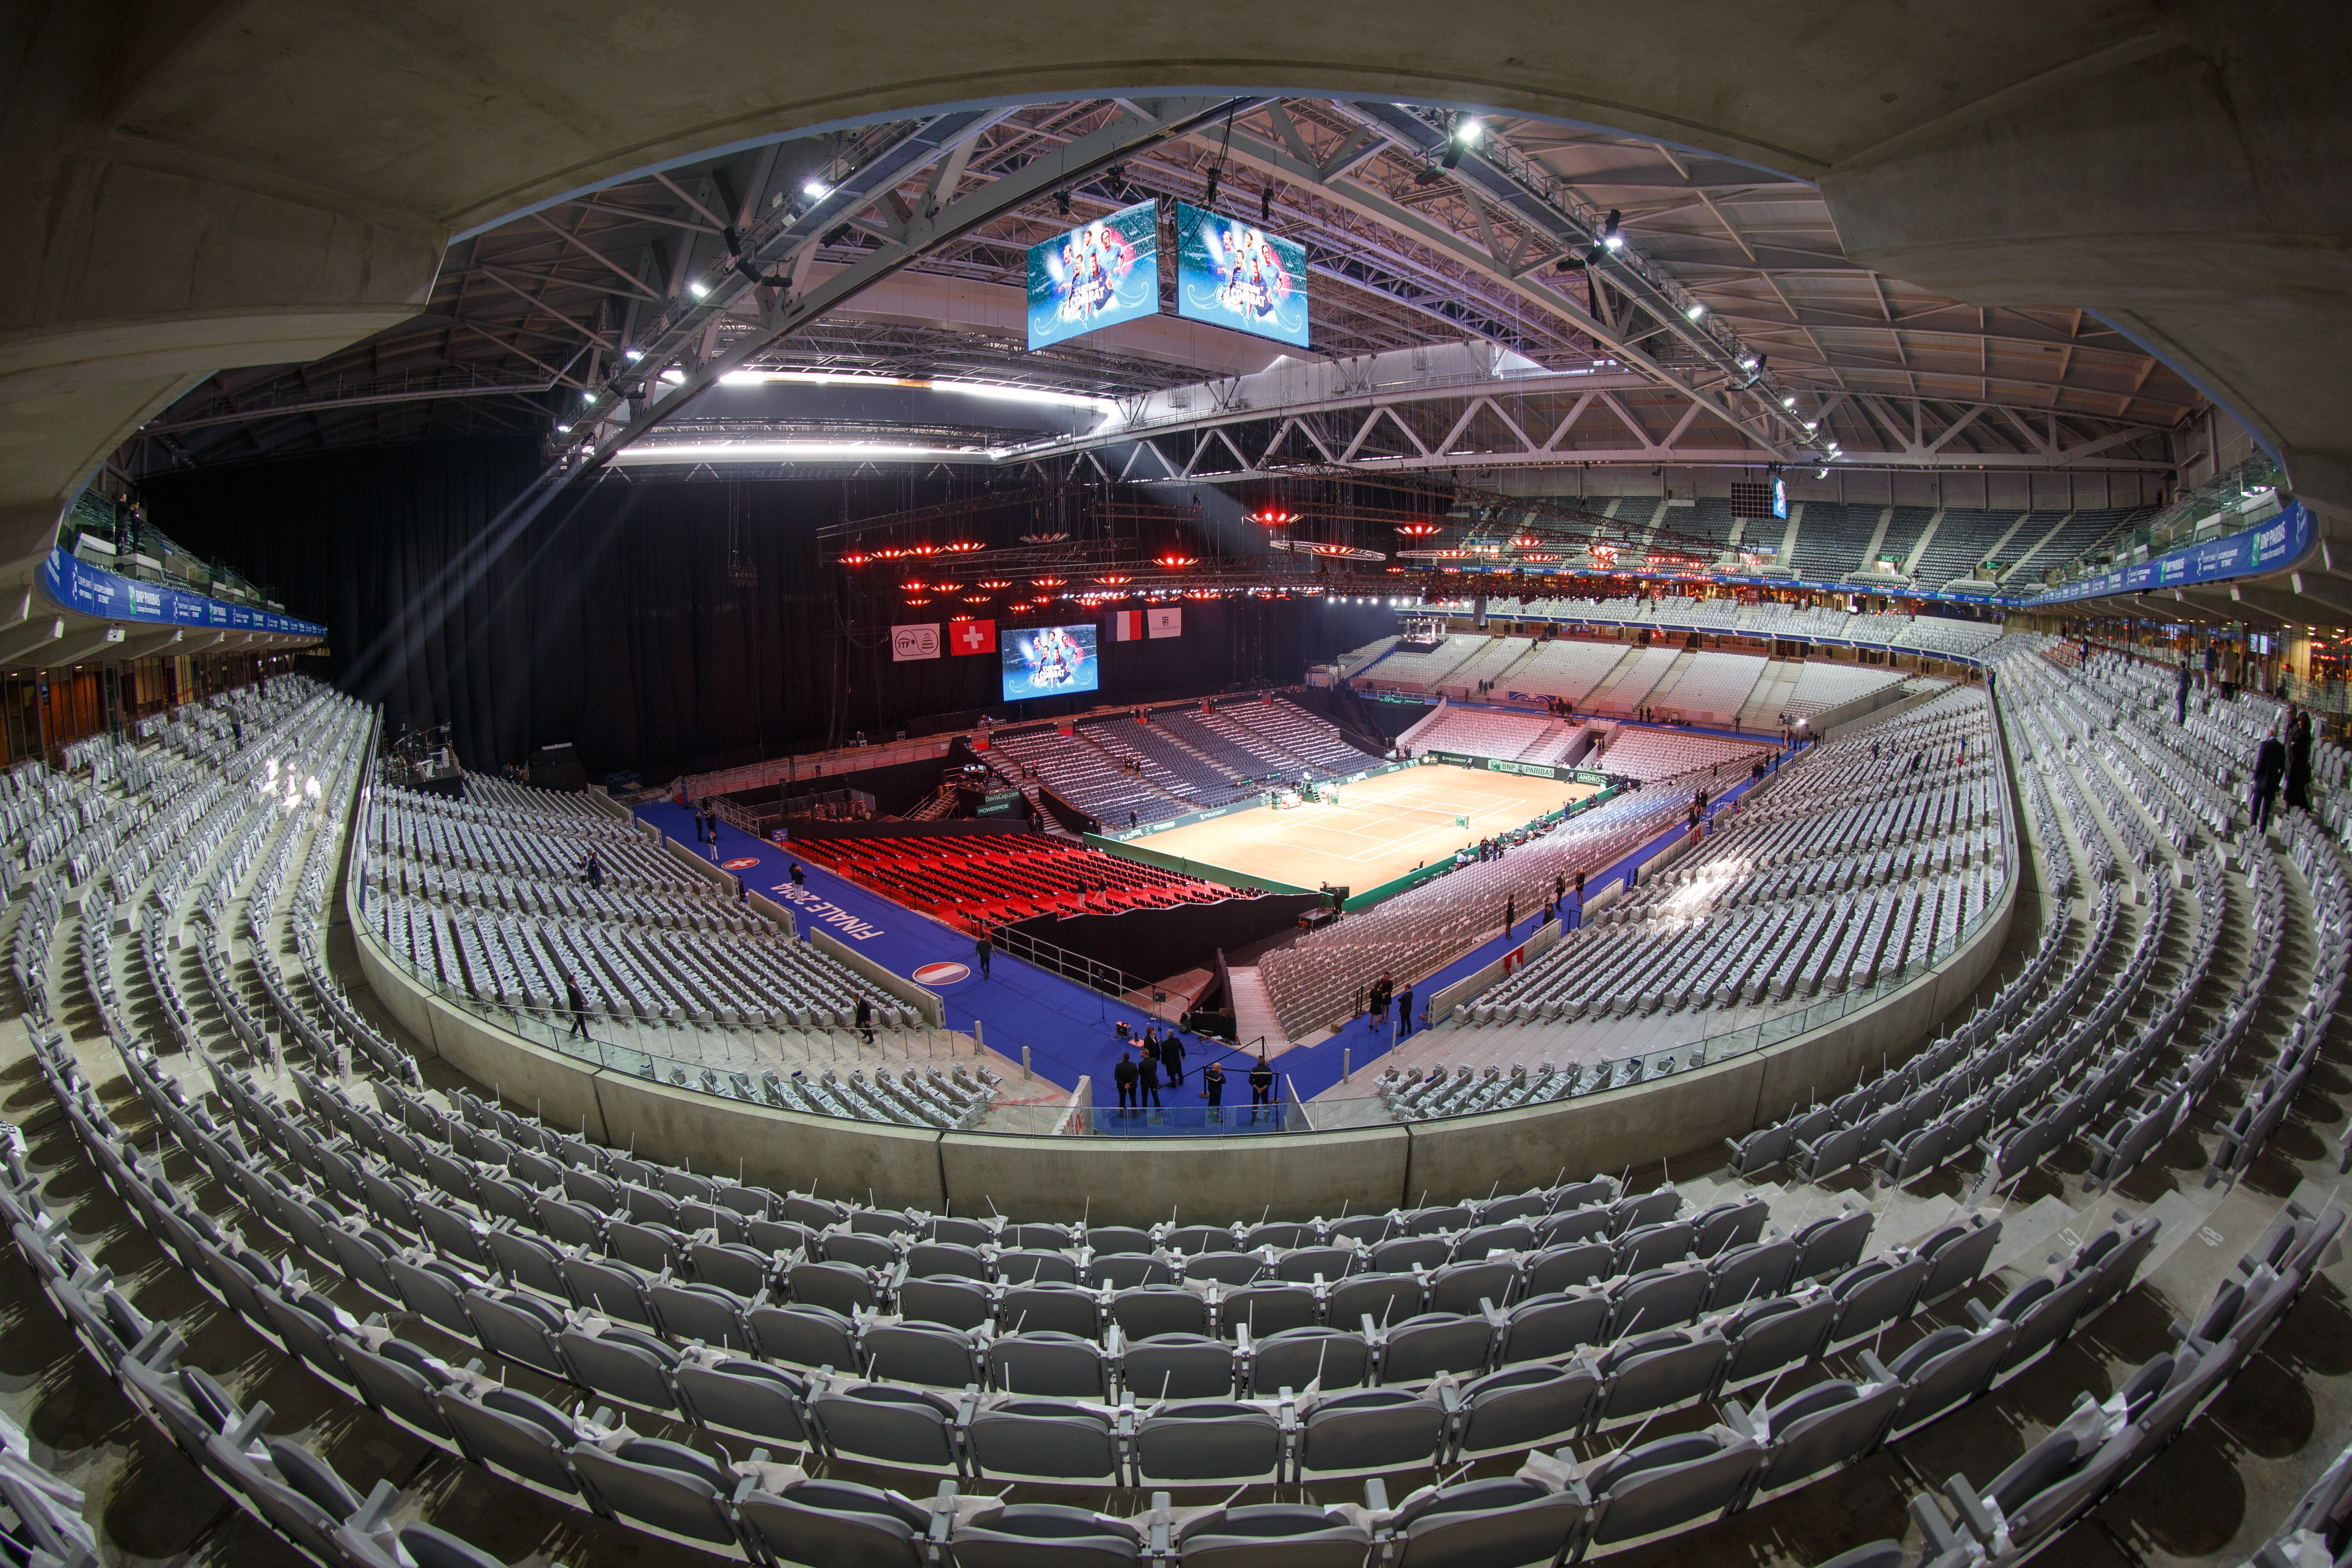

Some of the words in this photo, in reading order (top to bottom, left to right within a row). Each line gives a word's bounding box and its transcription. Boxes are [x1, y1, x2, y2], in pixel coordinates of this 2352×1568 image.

[1070, 286, 1105, 308] COMBAT
[1231, 287, 1265, 307] COMBAT
[135, 590, 144, 603] BNP
[144, 592, 161, 606] PARIBAS
[1039, 669, 1065, 679] COMBAT
[1526, 766, 1553, 776] PARIBAS
[1578, 774, 1602, 783] ANDRO
[985, 791, 1019, 802] DavisCup.com
[978, 804, 1009, 814] POWERADE
[1204, 809, 1227, 818] PEUGEOT
[770, 883, 821, 905] 2014
[804, 902, 885, 940] FINALE
[2058, 1228, 2082, 1247] 47
[2197, 1226, 2224, 1247] 48
